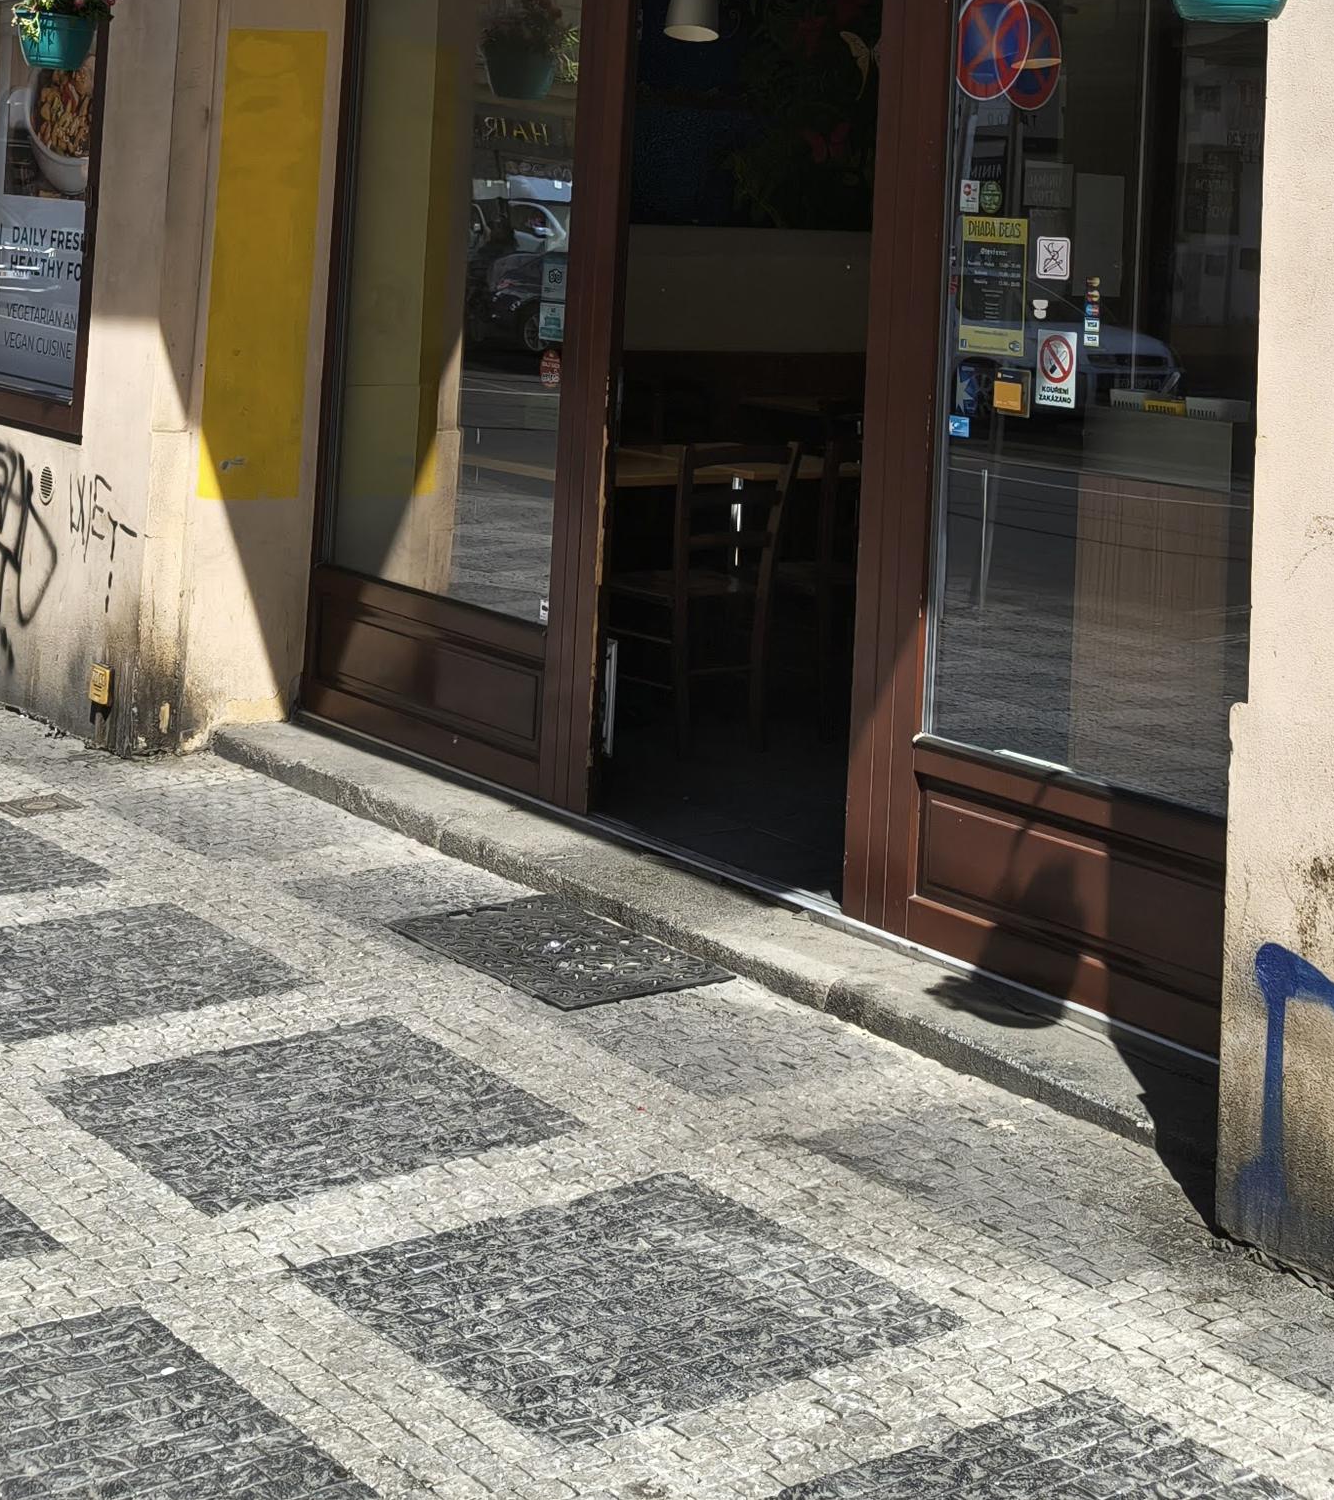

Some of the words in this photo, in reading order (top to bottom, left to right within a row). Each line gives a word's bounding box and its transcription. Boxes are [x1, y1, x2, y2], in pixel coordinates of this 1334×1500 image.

[13, 226, 47, 247] DAILY
[968, 220, 996, 237] DHABA
[999, 222, 1022, 239] BEAS
[11, 254, 64, 280] HEALTHY
[6, 303, 62, 327] VEGETARIAN
[4, 331, 34, 352] VEGAN
[36, 336, 73, 360] CUISINE
[1038, 393, 1072, 404] ZAKÁZÁNO
[1041, 384, 1069, 395] KOUŘENÍ
